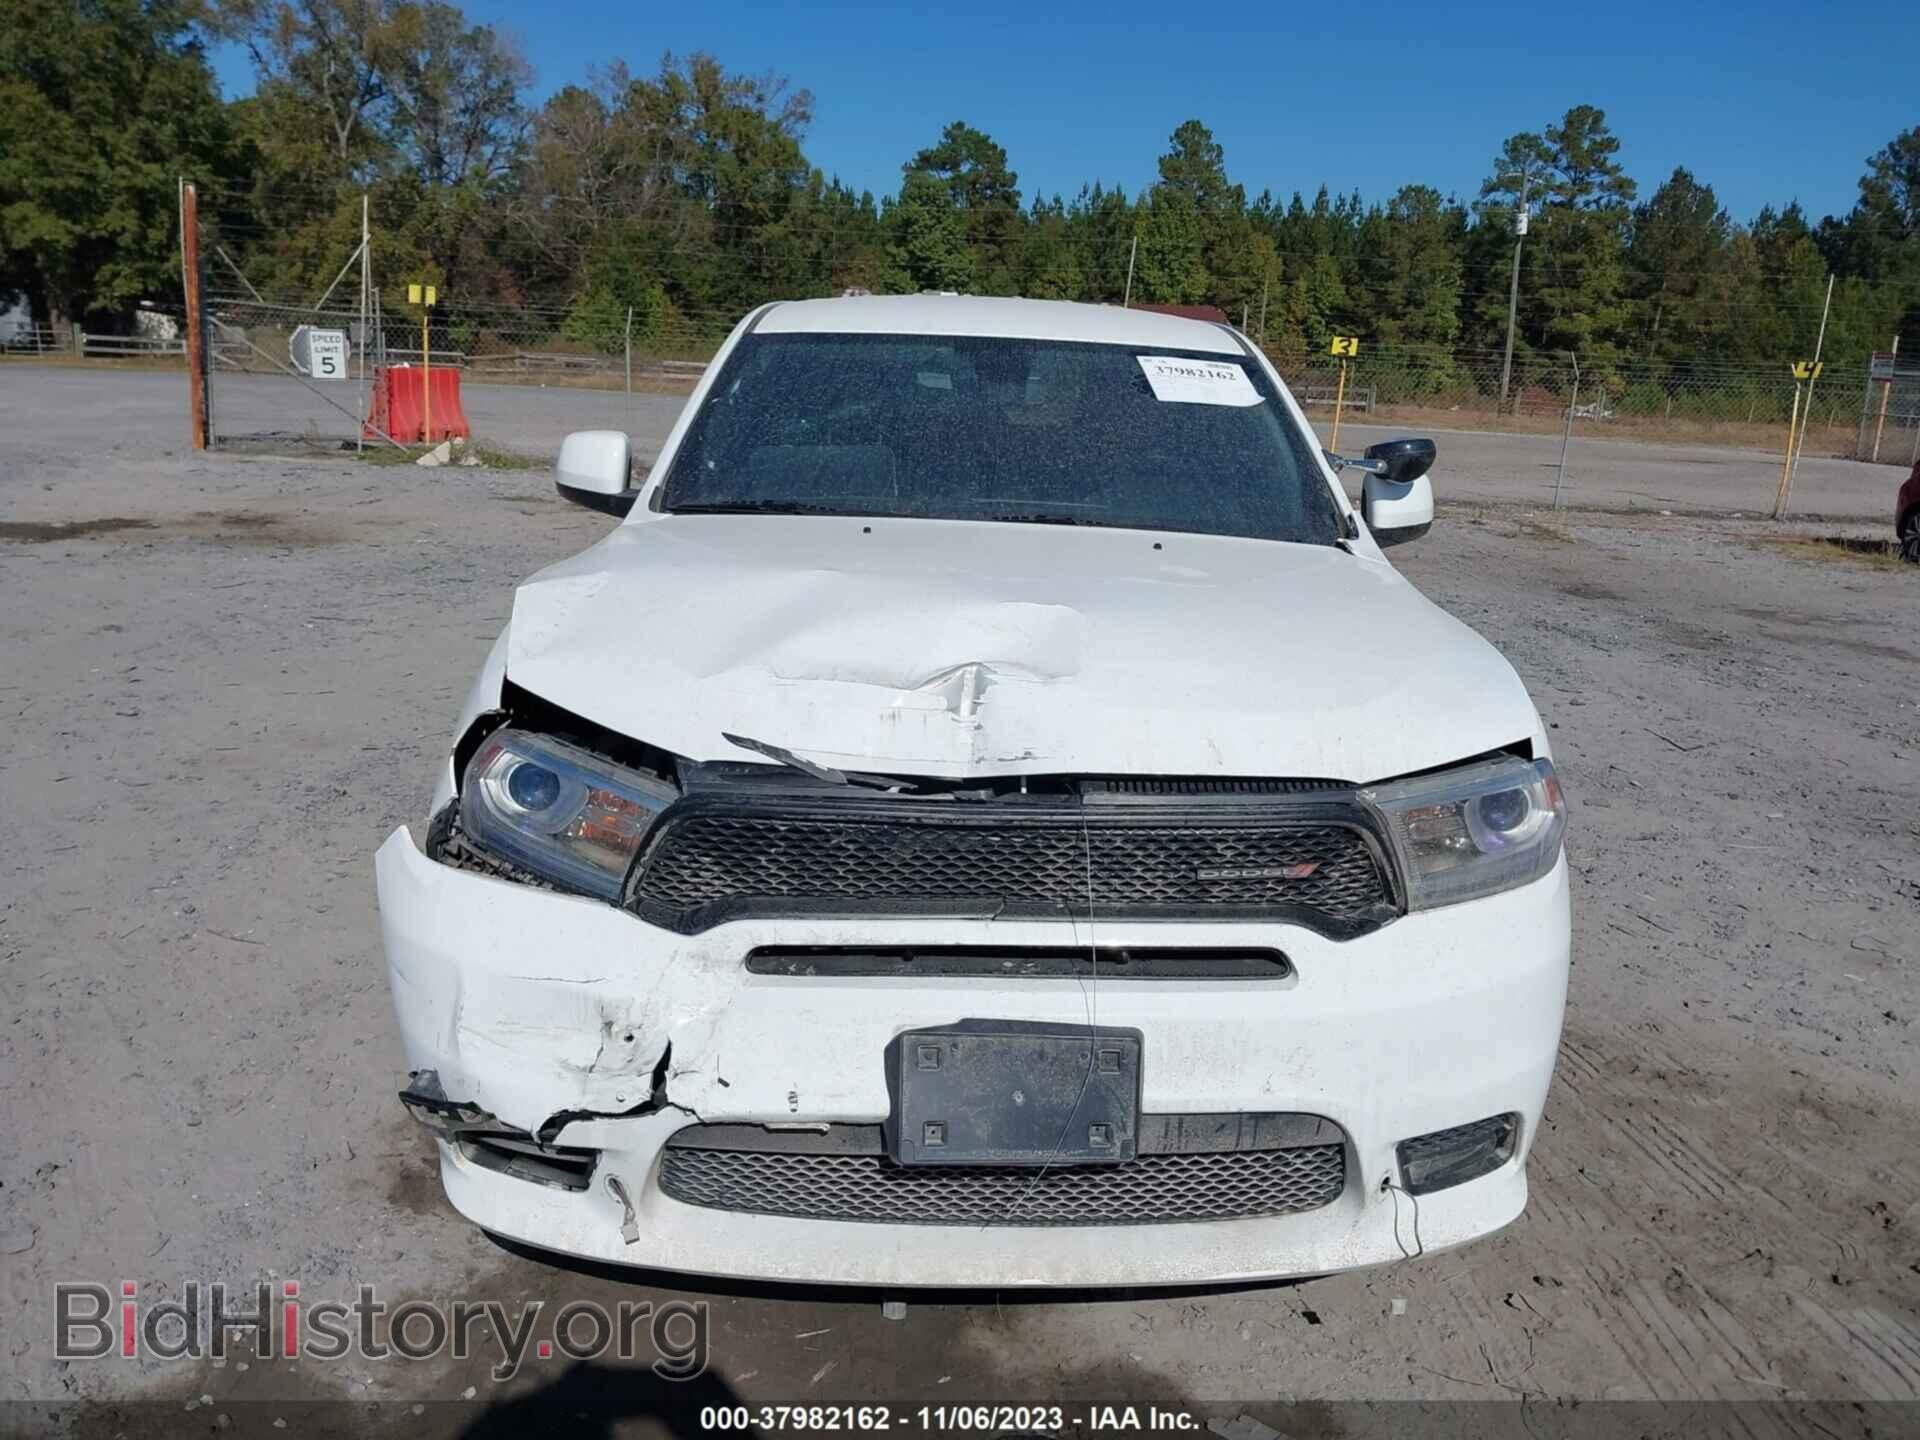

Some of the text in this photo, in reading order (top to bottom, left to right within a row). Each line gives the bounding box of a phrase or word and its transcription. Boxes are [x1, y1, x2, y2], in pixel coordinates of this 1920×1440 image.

[312, 335, 341, 343] SPEED
[322, 356, 336, 374] 5
[1154, 365, 1238, 381] 37982162
